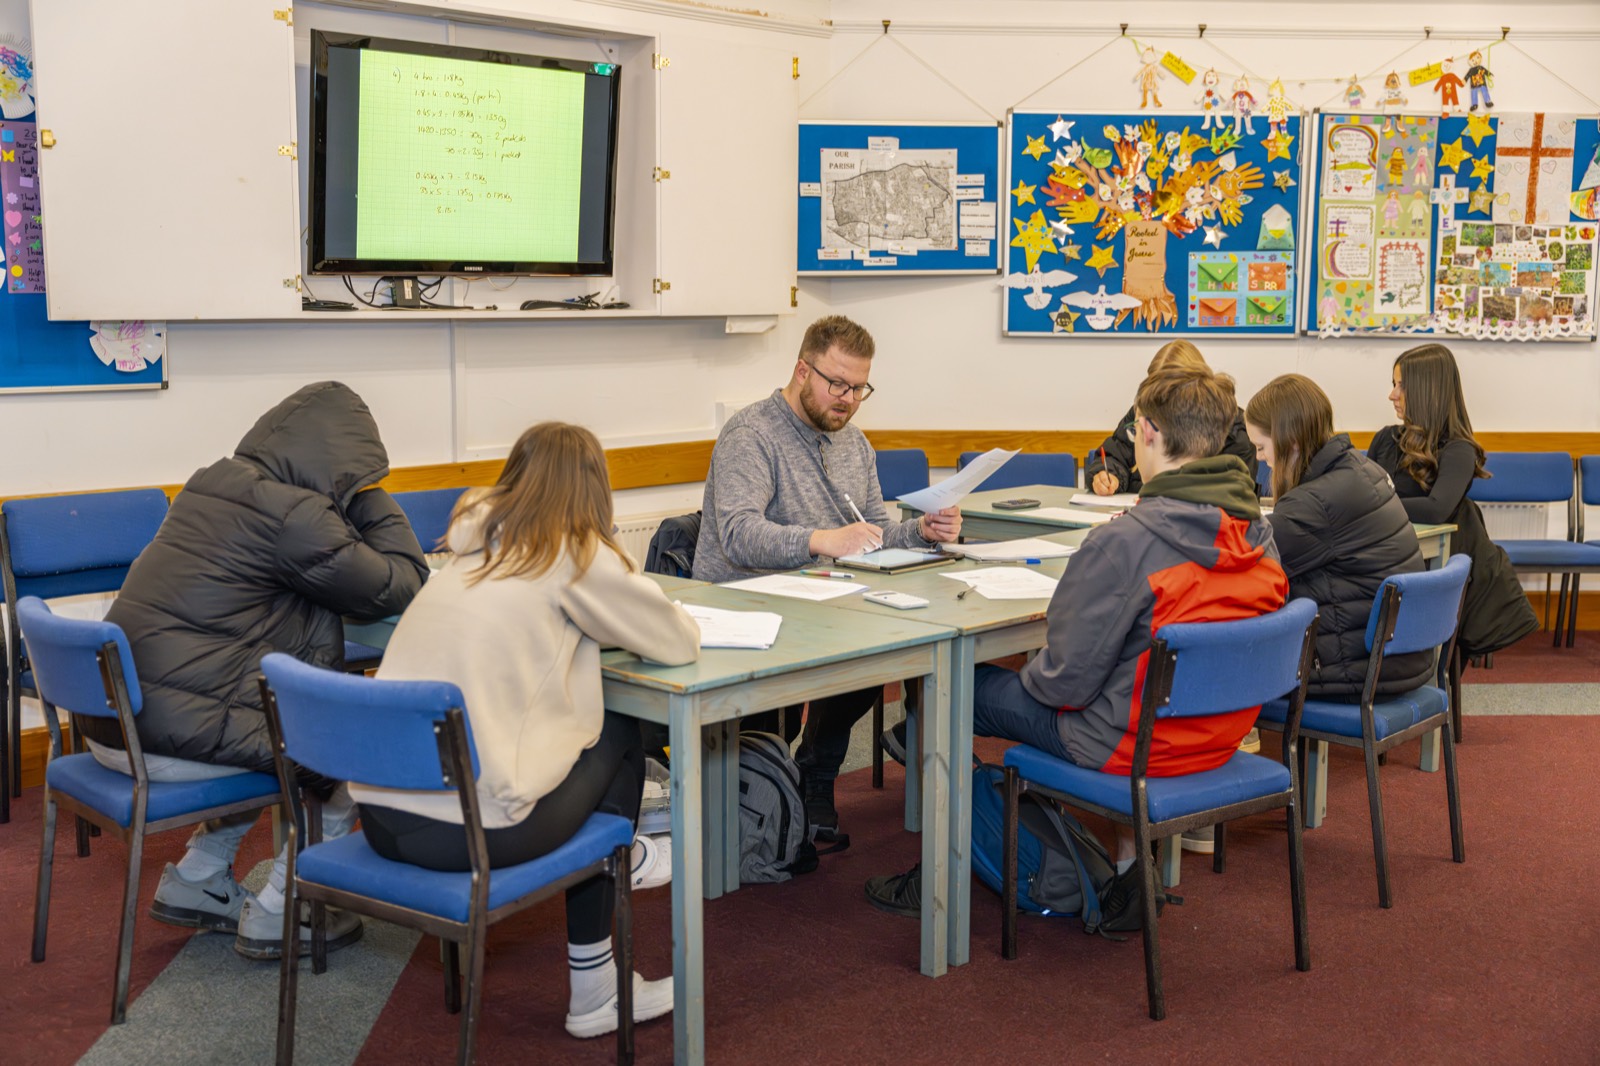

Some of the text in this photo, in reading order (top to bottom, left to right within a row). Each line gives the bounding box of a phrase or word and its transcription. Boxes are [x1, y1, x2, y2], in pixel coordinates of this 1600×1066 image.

[828, 162, 855, 170] PARISH
[1126, 226, 1159, 238] Rooted
[1139, 238, 1148, 246] in
[1127, 247, 1155, 262] Jesus
